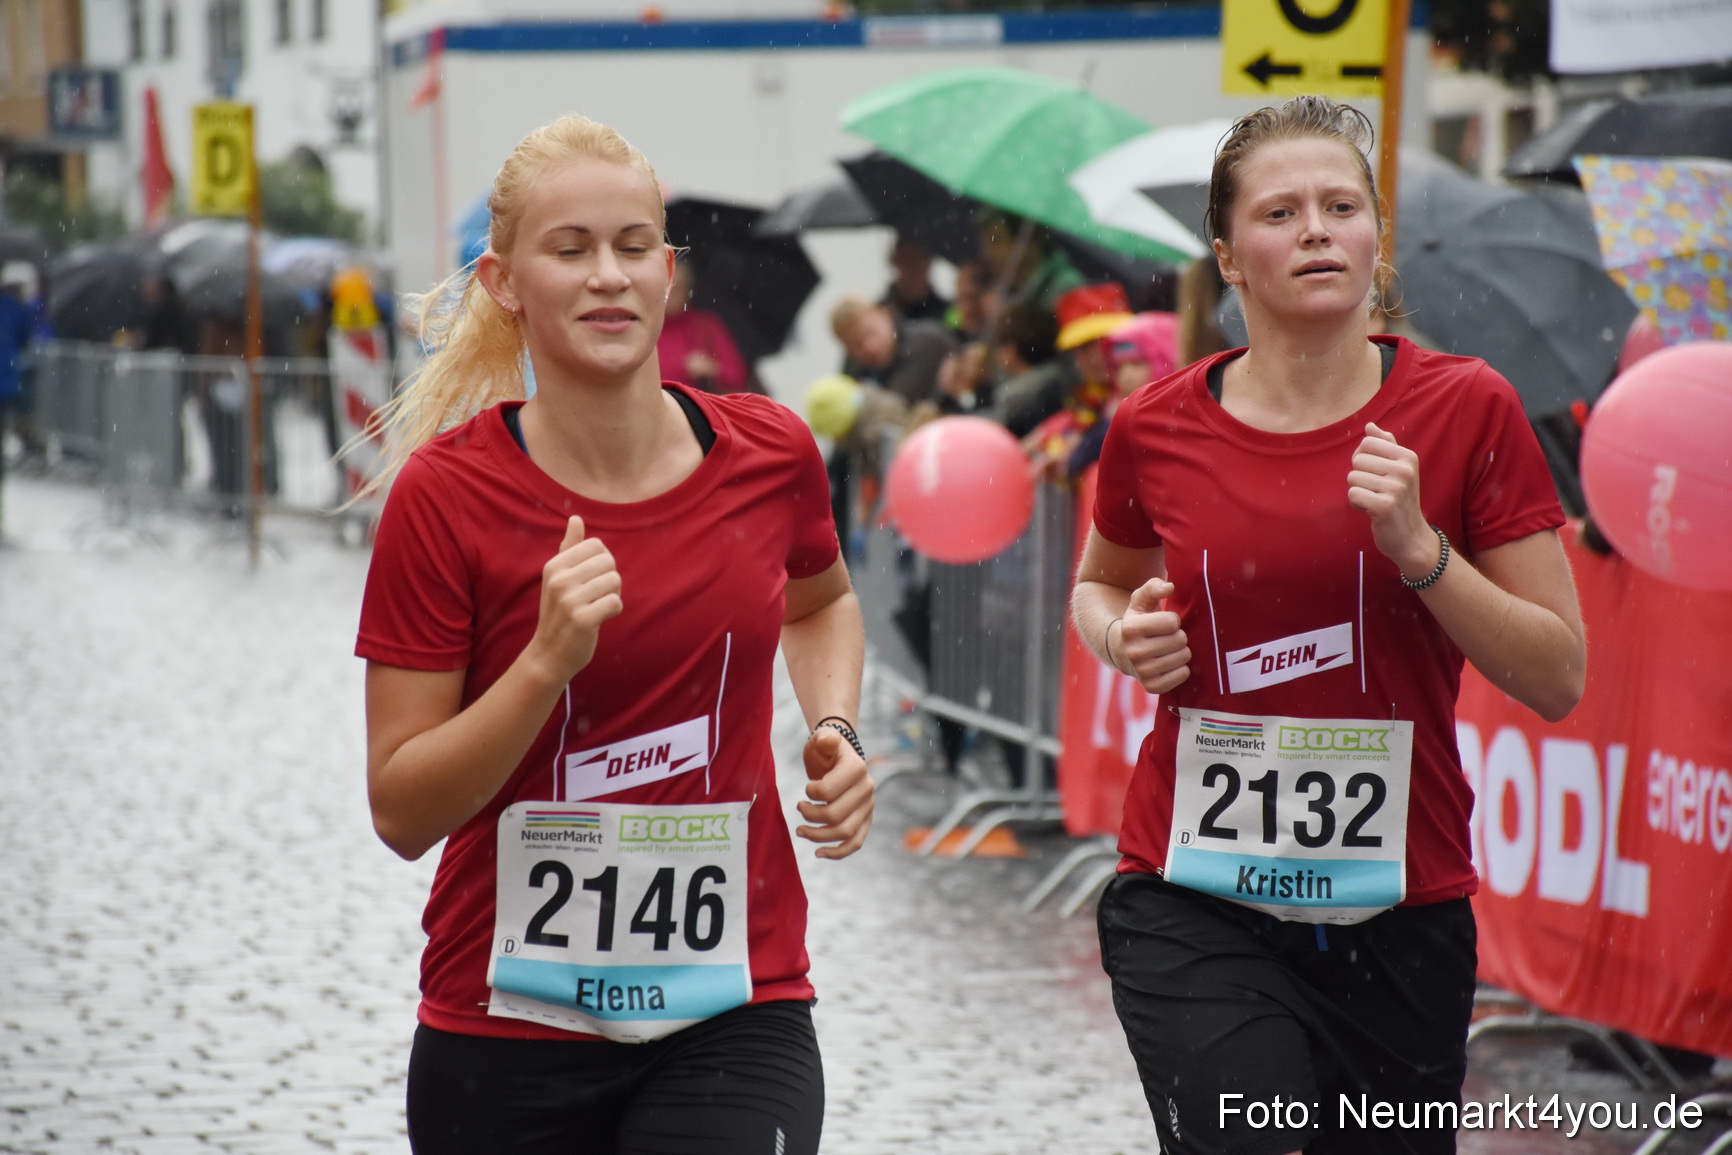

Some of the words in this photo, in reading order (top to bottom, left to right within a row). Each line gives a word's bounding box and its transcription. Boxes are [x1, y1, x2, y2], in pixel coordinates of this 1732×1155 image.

[206, 134, 242, 188] D
[1260, 643, 1317, 675] DEHN
[1195, 734, 1266, 751] NeuerMarkt
[1278, 725, 1390, 752] BOCK
[606, 742, 671, 779] DEHN
[1277, 751, 1311, 760] inspired
[1313, 752, 1323, 761] by
[1352, 754, 1391, 762] concepts
[1198, 763, 1387, 848] 2132
[1648, 747, 1732, 854] enerG
[521, 829, 603, 844] NeuerMarkt
[619, 814, 731, 842] BOCK
[618, 844, 652, 853] inspired
[655, 844, 666, 853] by
[1236, 865, 1332, 900] Kristin
[524, 860, 727, 952] 2146
[575, 977, 666, 1012] Elena
